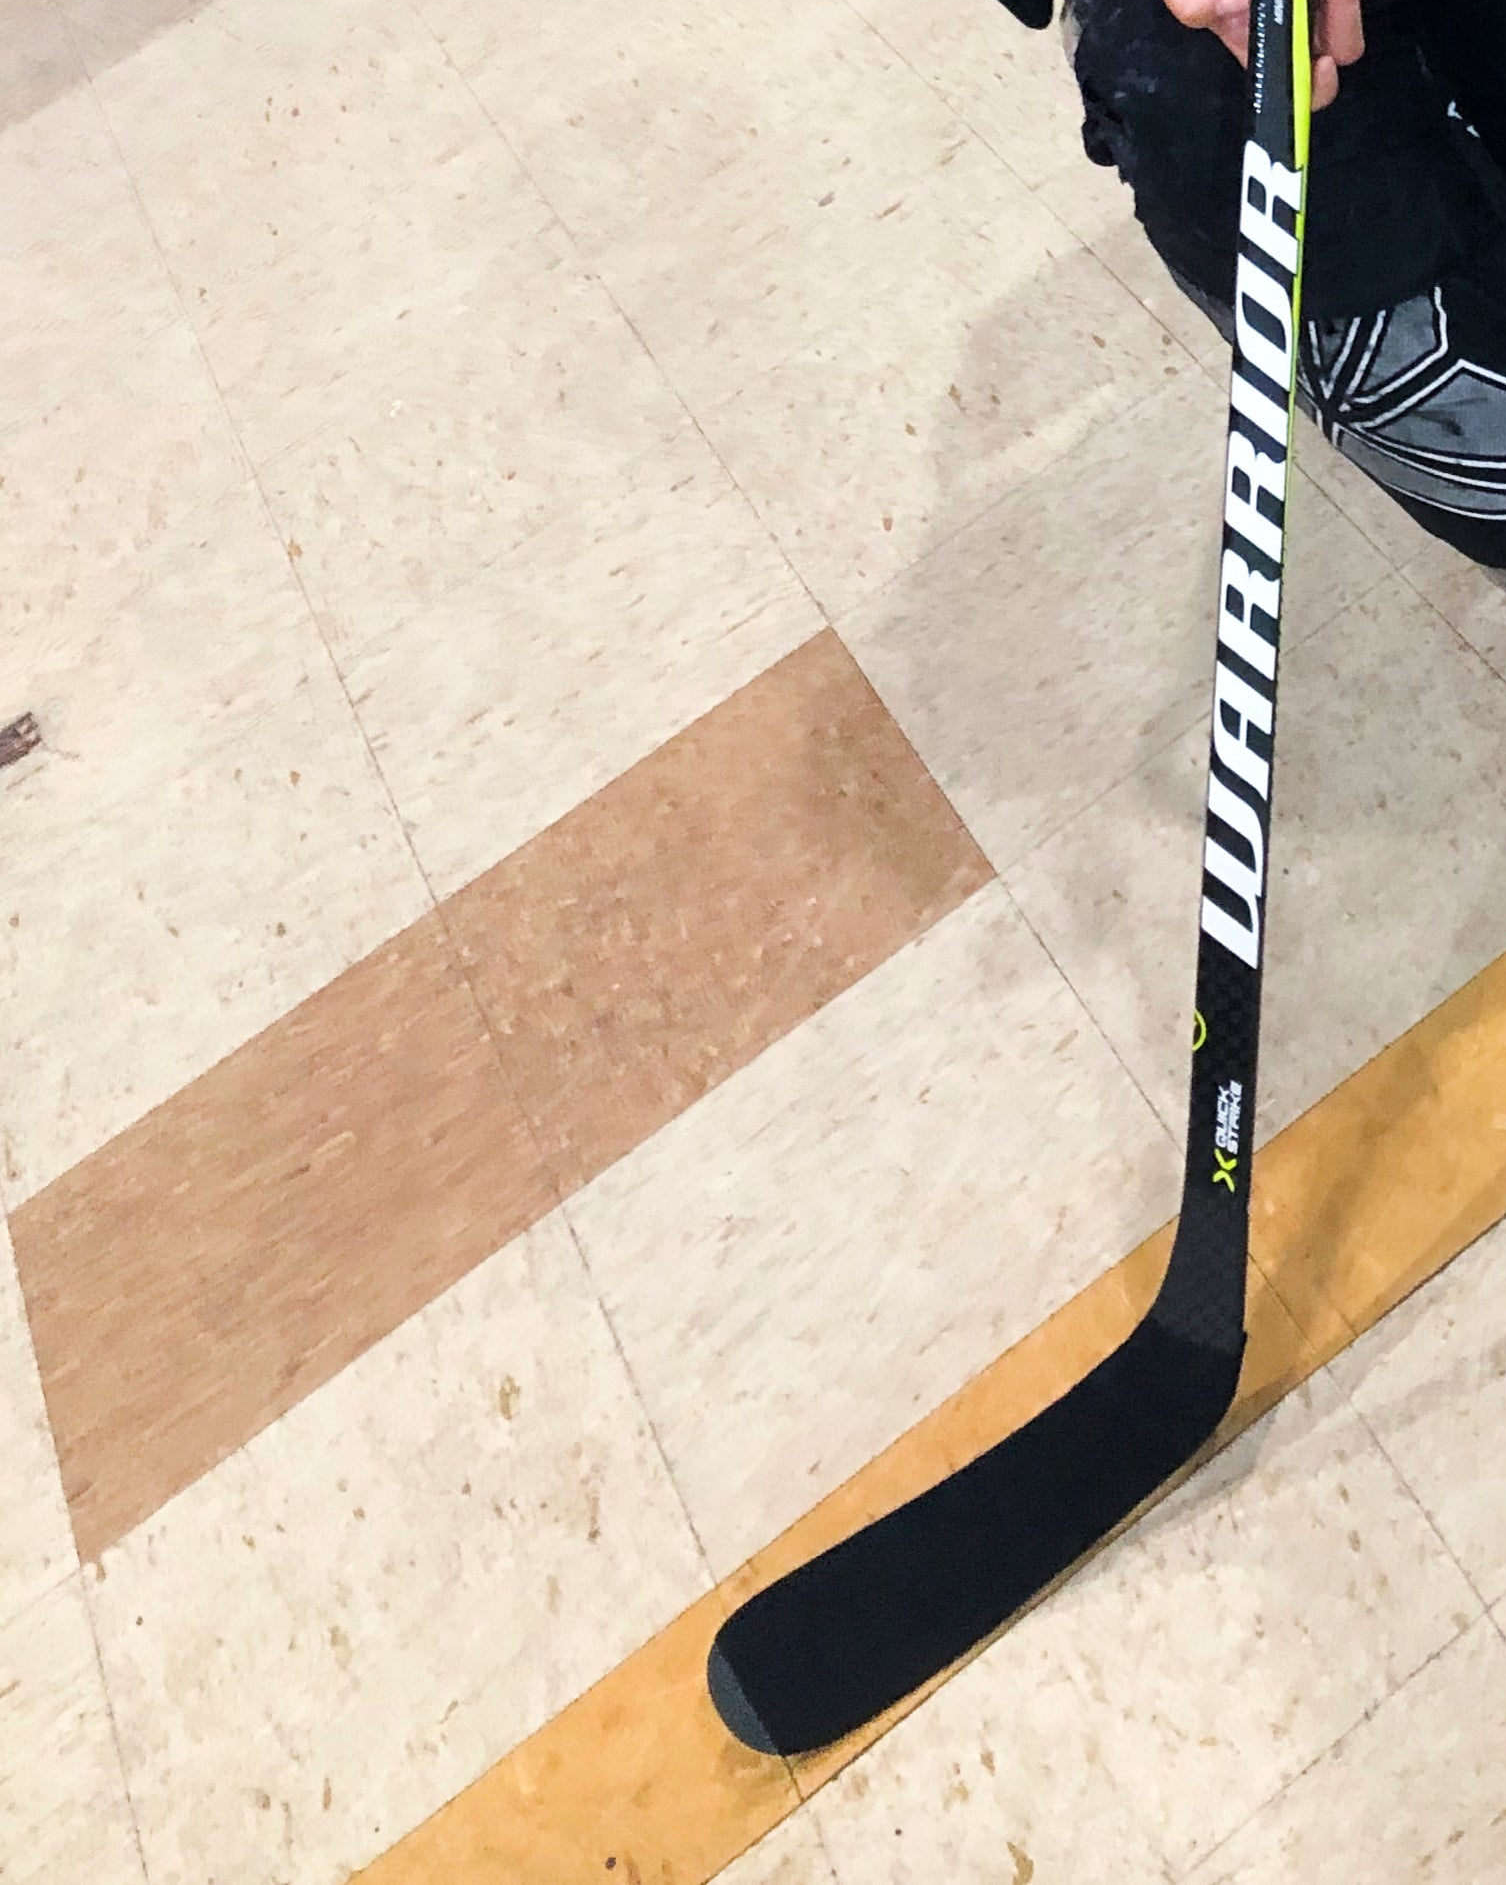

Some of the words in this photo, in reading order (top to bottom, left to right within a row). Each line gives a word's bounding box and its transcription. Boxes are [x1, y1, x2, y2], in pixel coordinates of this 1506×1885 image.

[1201, 139, 1306, 969] WARRIOR
[1215, 1084, 1230, 1149] QUICK
[1227, 1079, 1243, 1155] STRIKE
